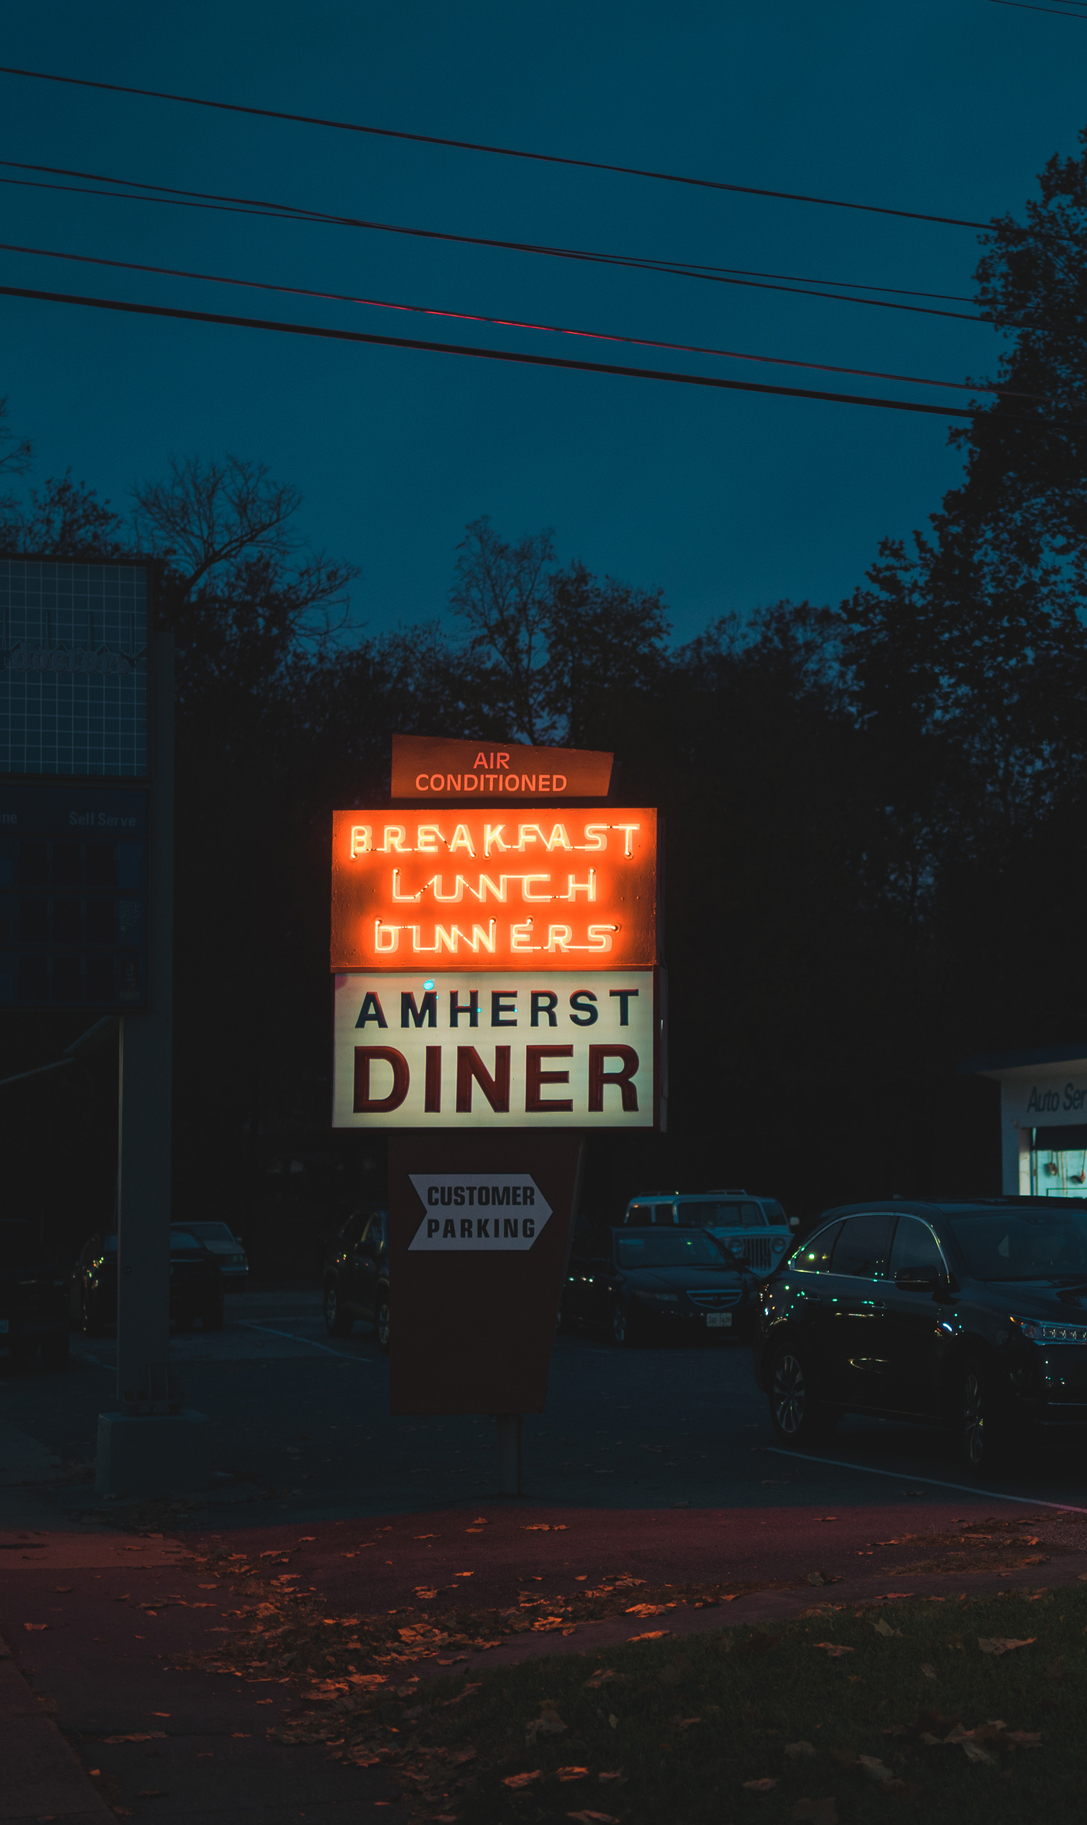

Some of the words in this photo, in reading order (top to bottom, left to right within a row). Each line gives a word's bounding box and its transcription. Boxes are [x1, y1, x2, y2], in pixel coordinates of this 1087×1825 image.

[473, 752, 511, 770] AIR
[415, 774, 568, 792] CONDITIONED
[68, 811, 95, 826] Self
[97, 812, 137, 827] Serve
[351, 824, 640, 854] BREAKFAST
[392, 873, 597, 903] LUNCH
[374, 924, 613, 954] DINNERS
[354, 988, 640, 1029] AMHERST
[353, 1044, 641, 1114] DINER
[1025, 1085, 1060, 1113] Auto
[426, 1186, 536, 1206] CUSTOMER
[426, 1218, 536, 1239] PARKING
